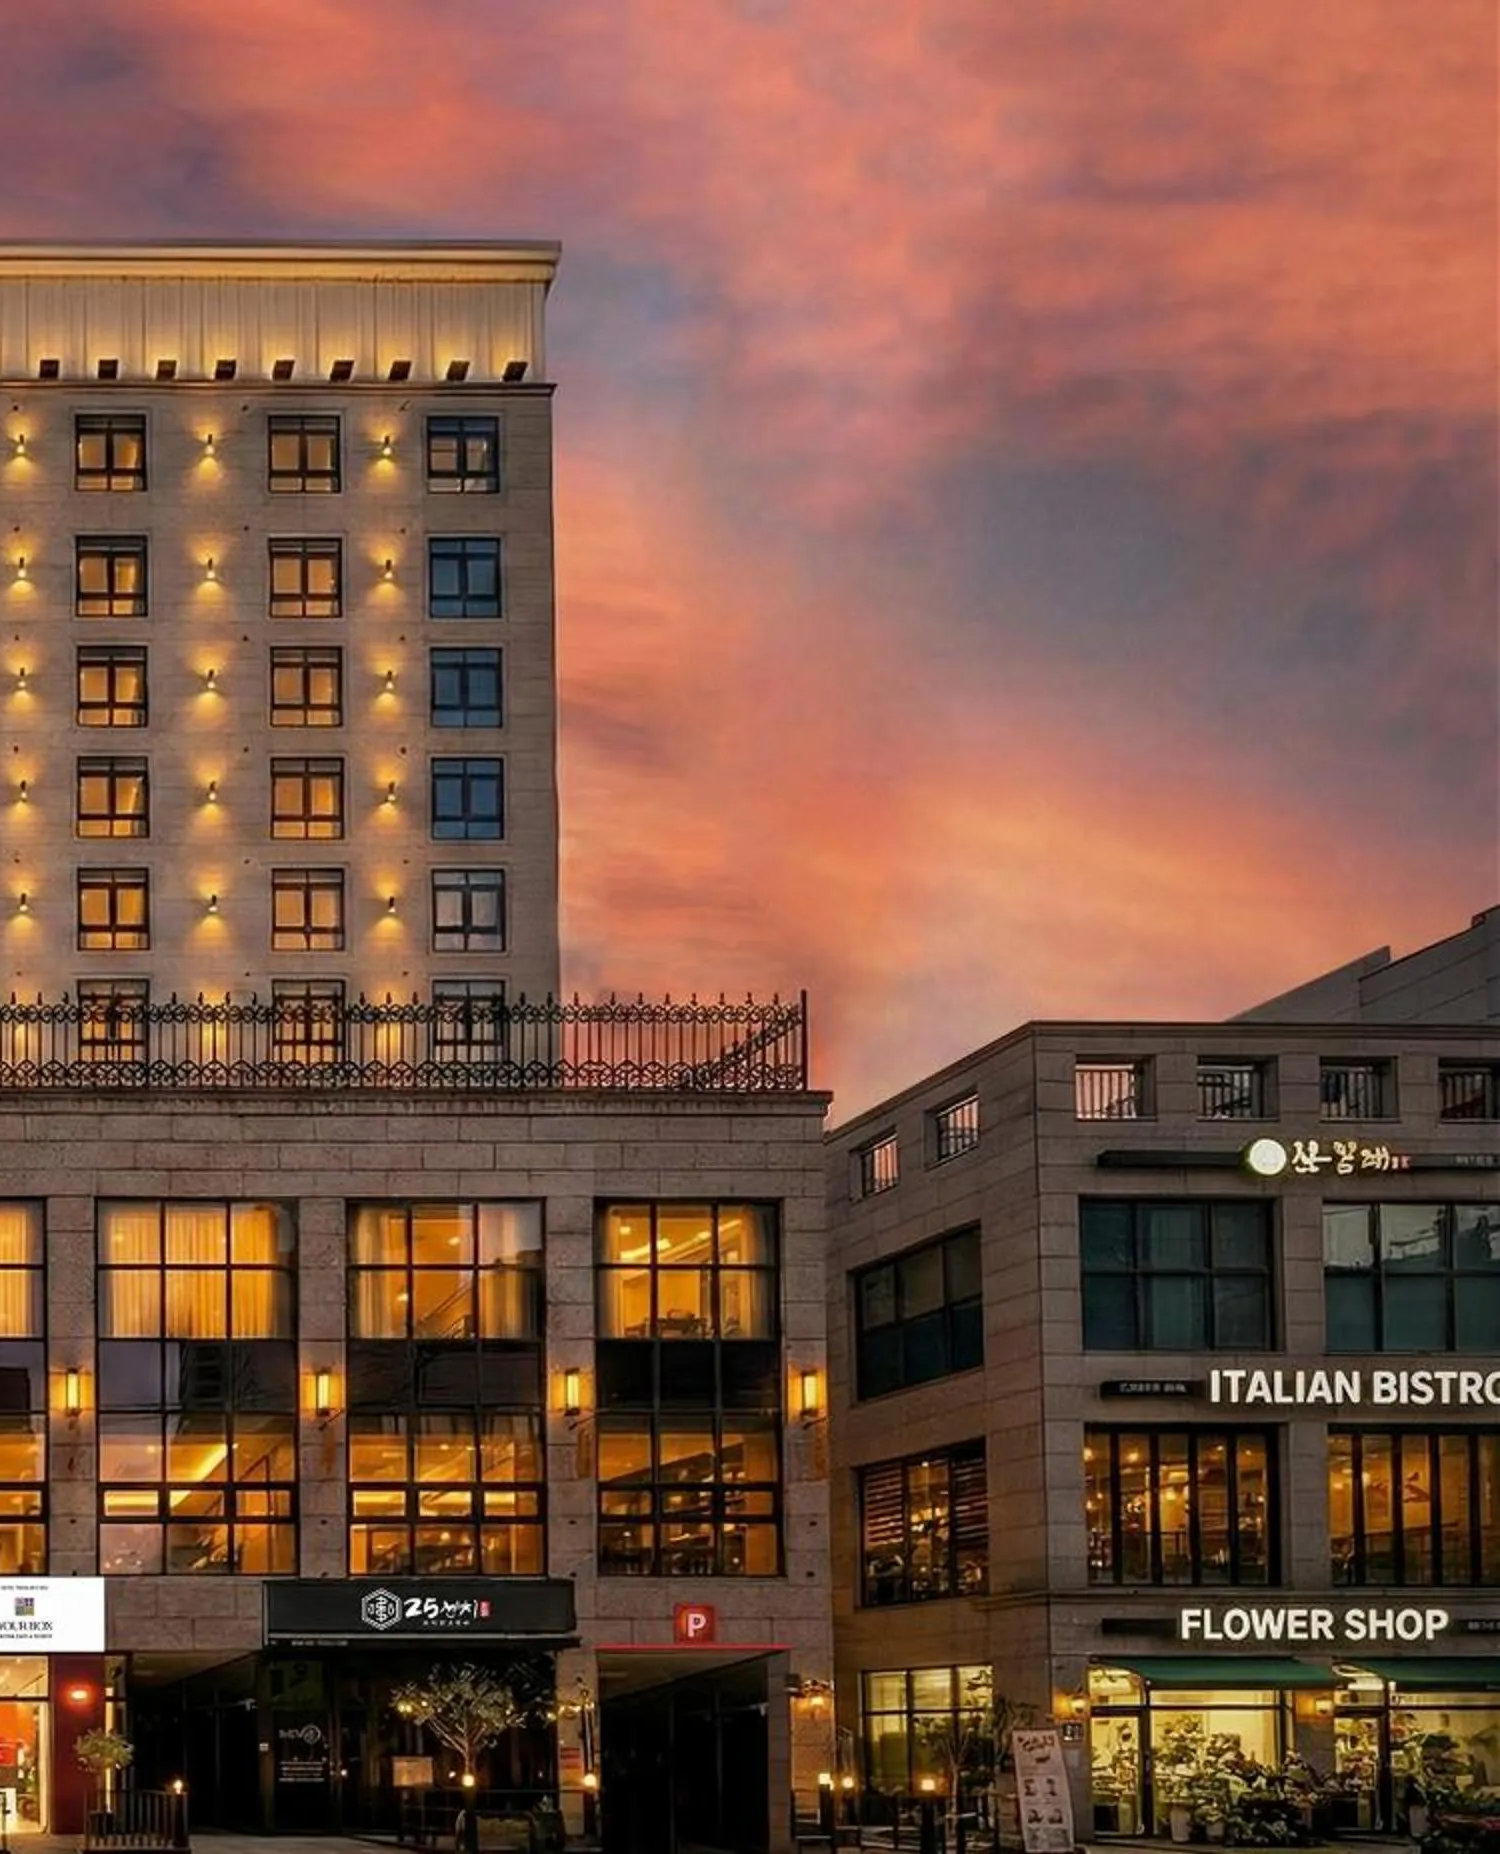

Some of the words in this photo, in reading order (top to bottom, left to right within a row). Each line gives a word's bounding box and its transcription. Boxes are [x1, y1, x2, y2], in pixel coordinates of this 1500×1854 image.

[1210, 1369, 1361, 1404] ITALIAN
[687, 1613, 706, 1638] P
[1181, 1608, 1335, 1640] FLOWER
[1344, 1608, 1449, 1640] SHOP
